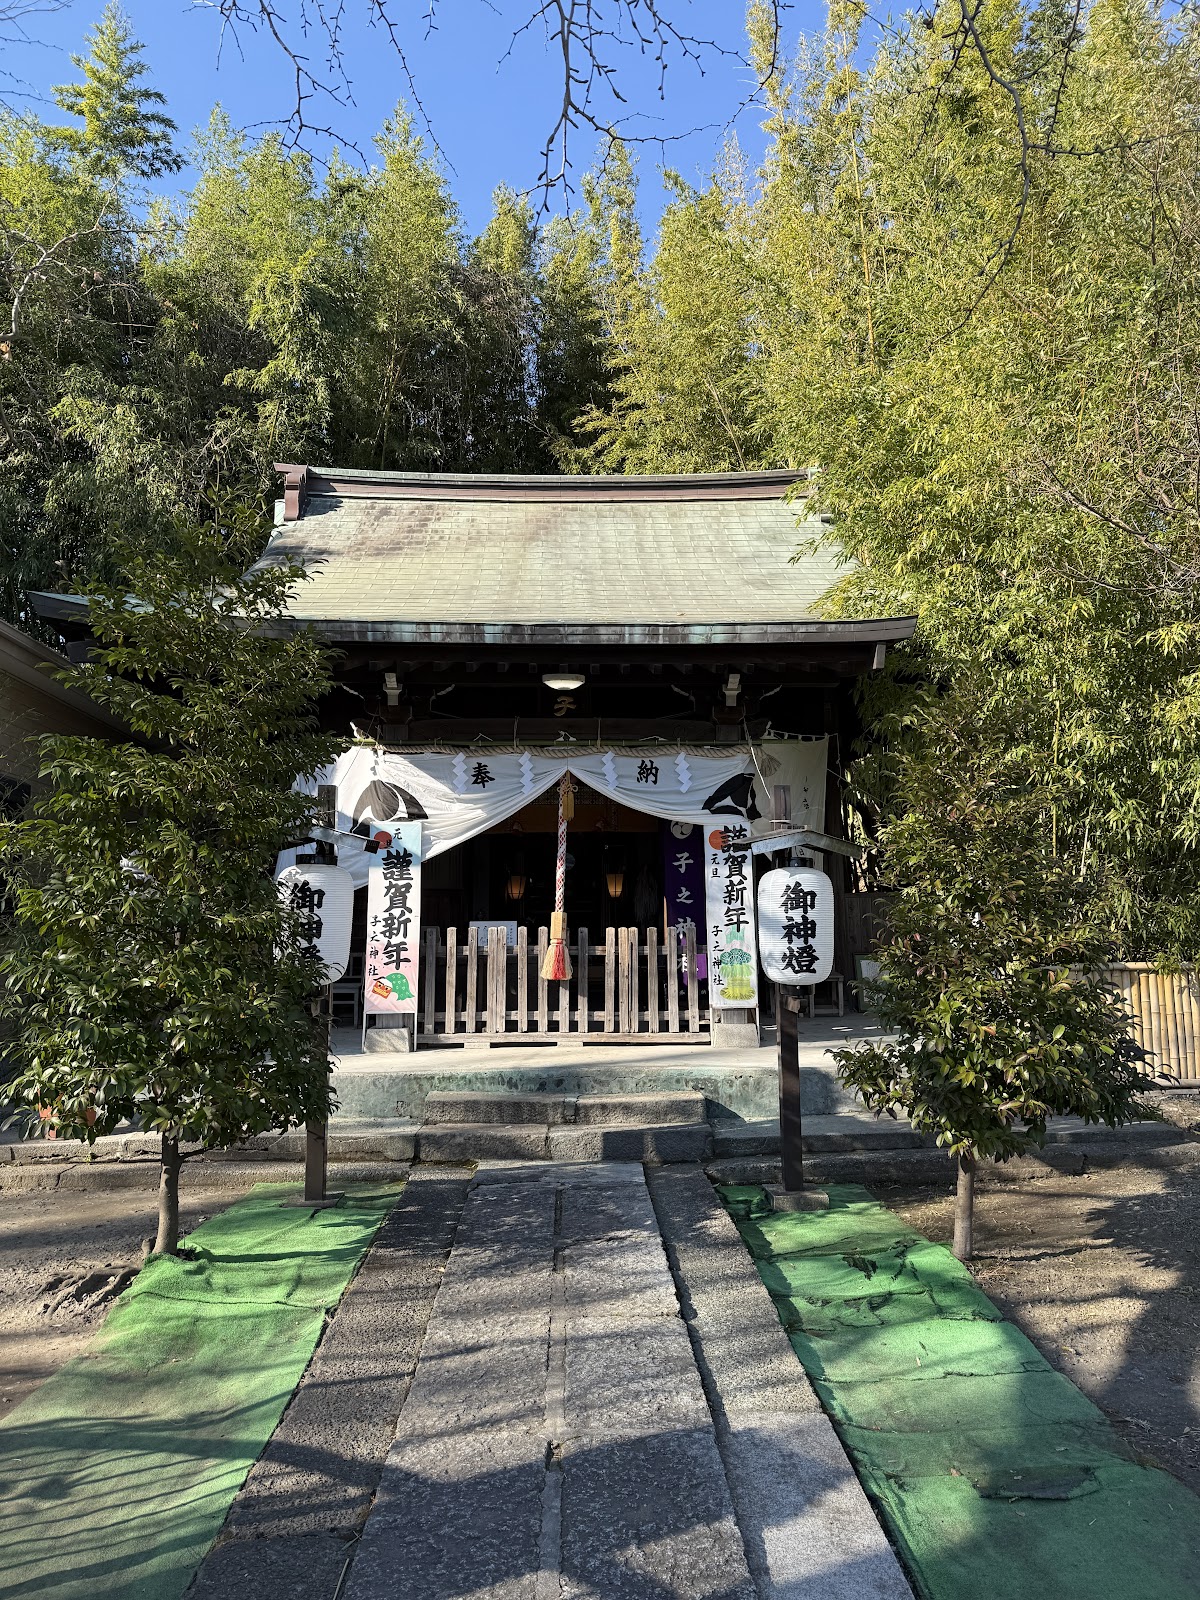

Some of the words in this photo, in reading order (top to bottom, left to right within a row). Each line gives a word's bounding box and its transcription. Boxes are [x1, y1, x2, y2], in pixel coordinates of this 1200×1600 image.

[470, 761, 496, 789] 奉
[636, 759, 660, 785] 納
[710, 853, 721, 879] 元旦
[720, 823, 752, 933] 謹賀新年
[380, 847, 414, 970] 謹賀新年
[778, 880, 820, 975] 御神燈
[711, 924, 725, 986] 子之神社
